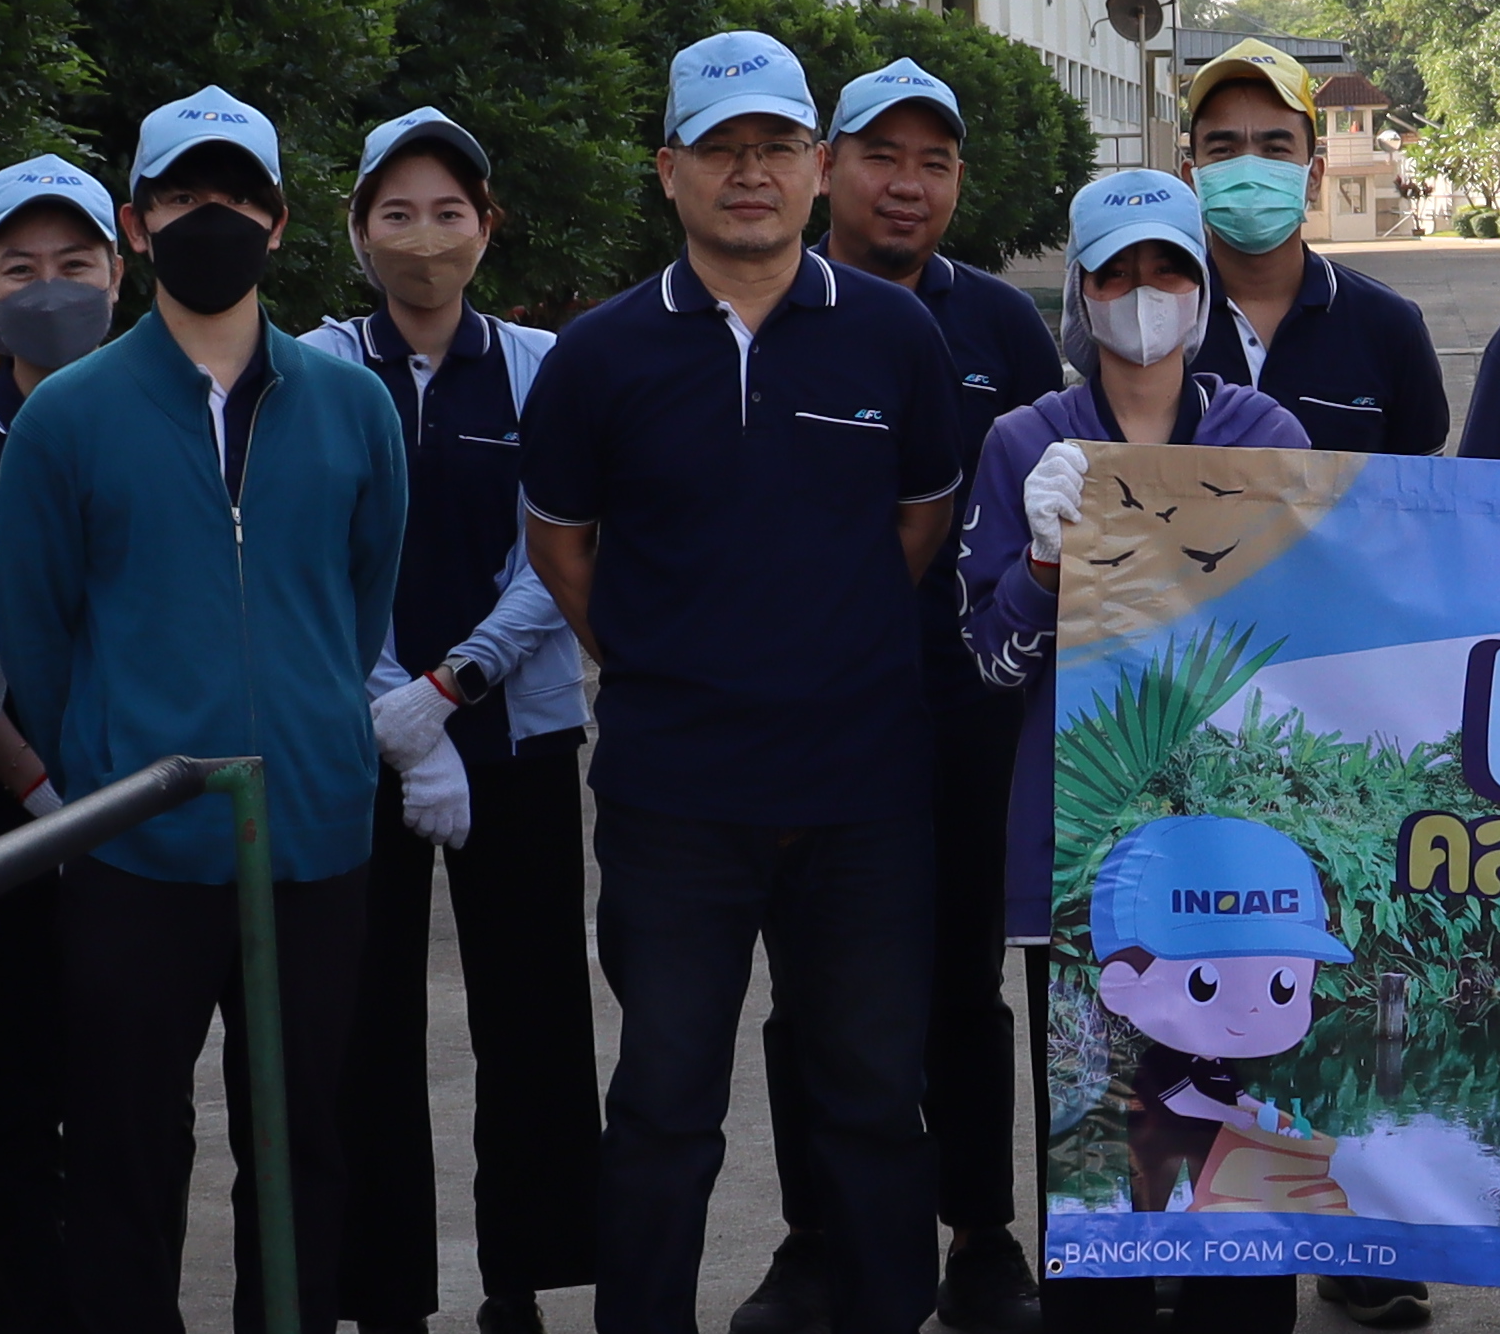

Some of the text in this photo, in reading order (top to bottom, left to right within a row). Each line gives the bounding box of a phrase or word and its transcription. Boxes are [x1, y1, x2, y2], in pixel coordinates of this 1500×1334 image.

[1171, 888, 1299, 914] INOAC
[1065, 1240, 1192, 1264] BANGKOK
[1204, 1240, 1284, 1262] FOAM
